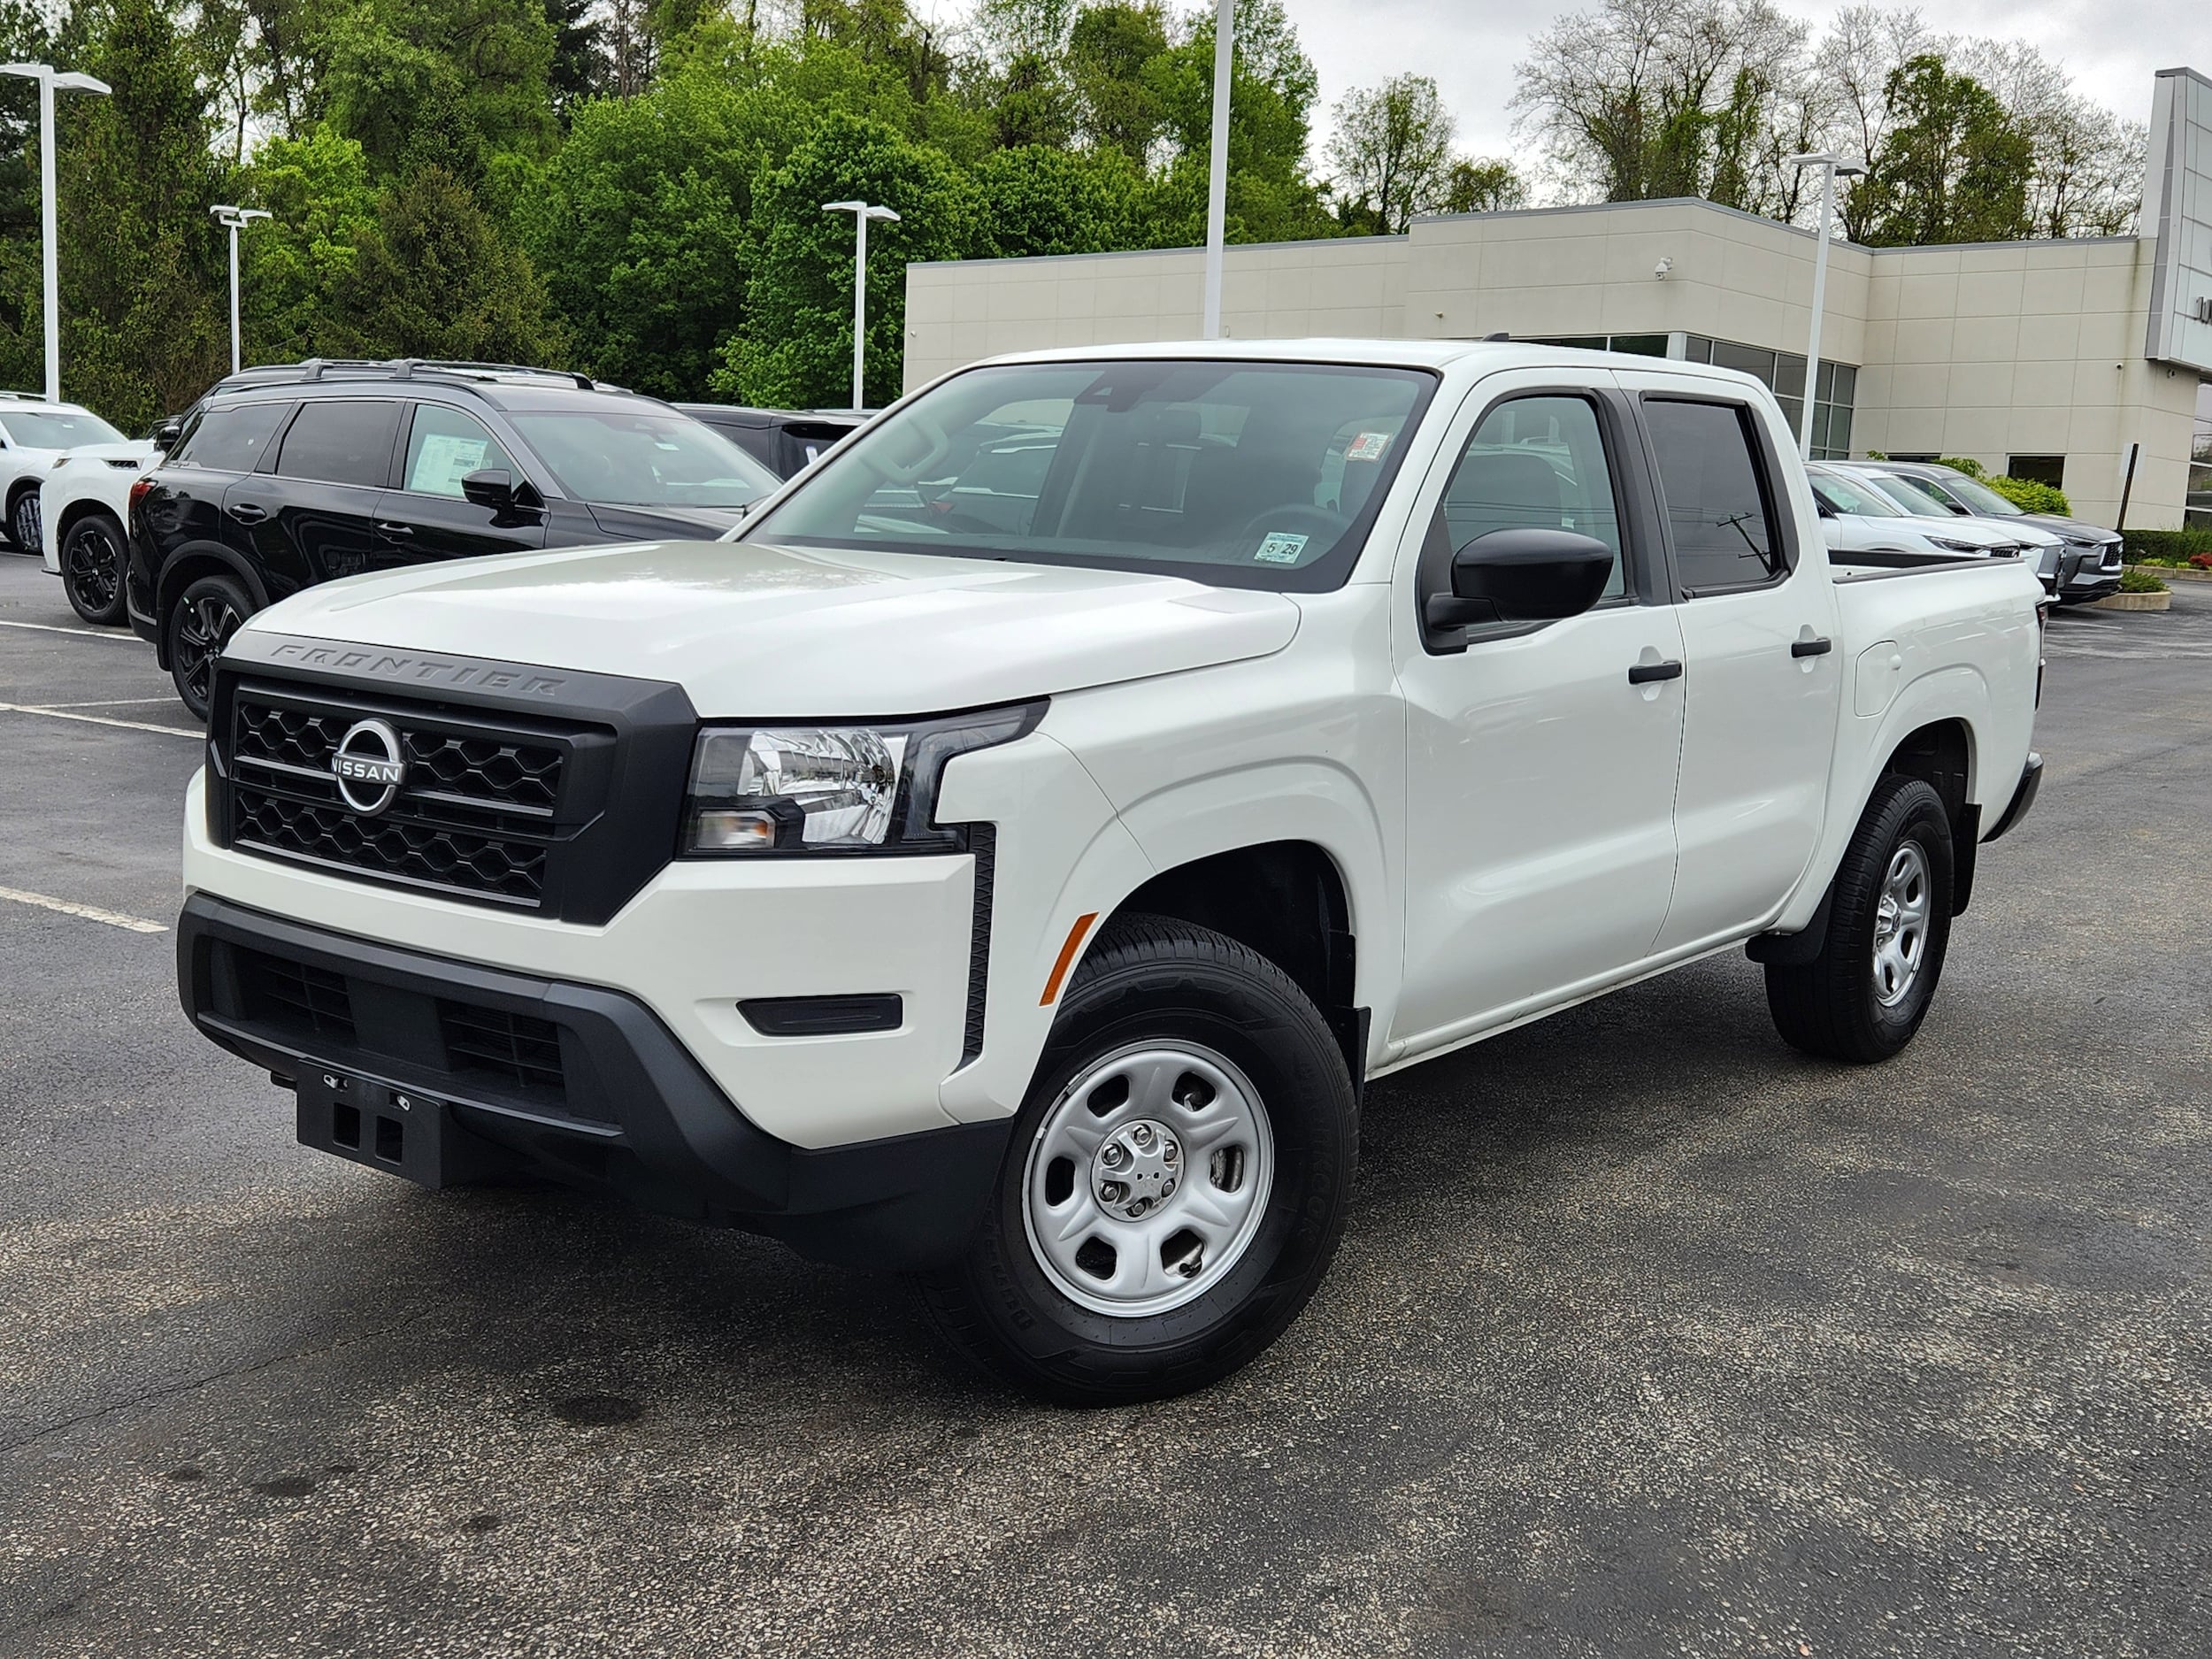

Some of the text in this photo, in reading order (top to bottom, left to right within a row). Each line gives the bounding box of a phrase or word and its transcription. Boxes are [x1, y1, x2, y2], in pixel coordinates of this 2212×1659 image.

[1266, 542, 1298, 555] 5 29
[270, 644, 566, 696] FRONTIER
[331, 757, 399, 781] NISSAN
